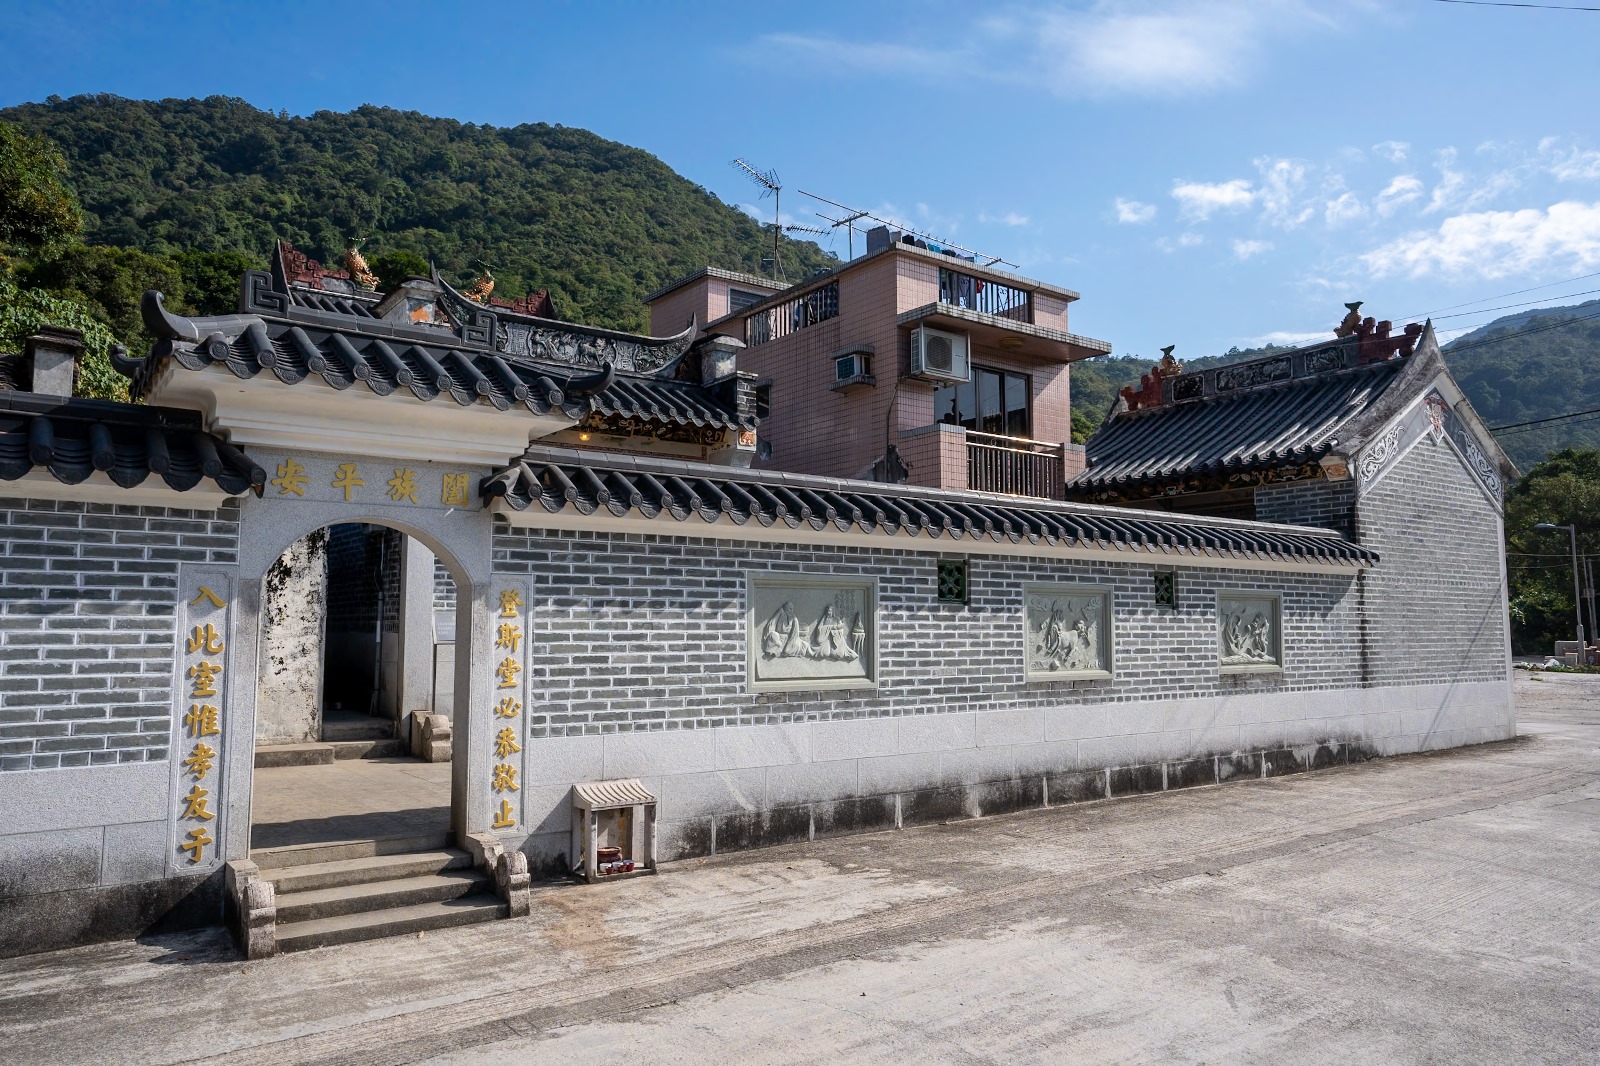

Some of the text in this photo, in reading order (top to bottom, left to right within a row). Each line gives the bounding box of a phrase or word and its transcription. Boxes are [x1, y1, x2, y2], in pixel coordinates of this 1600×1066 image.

[492, 589, 524, 828] 登斯堂必恭敬止
